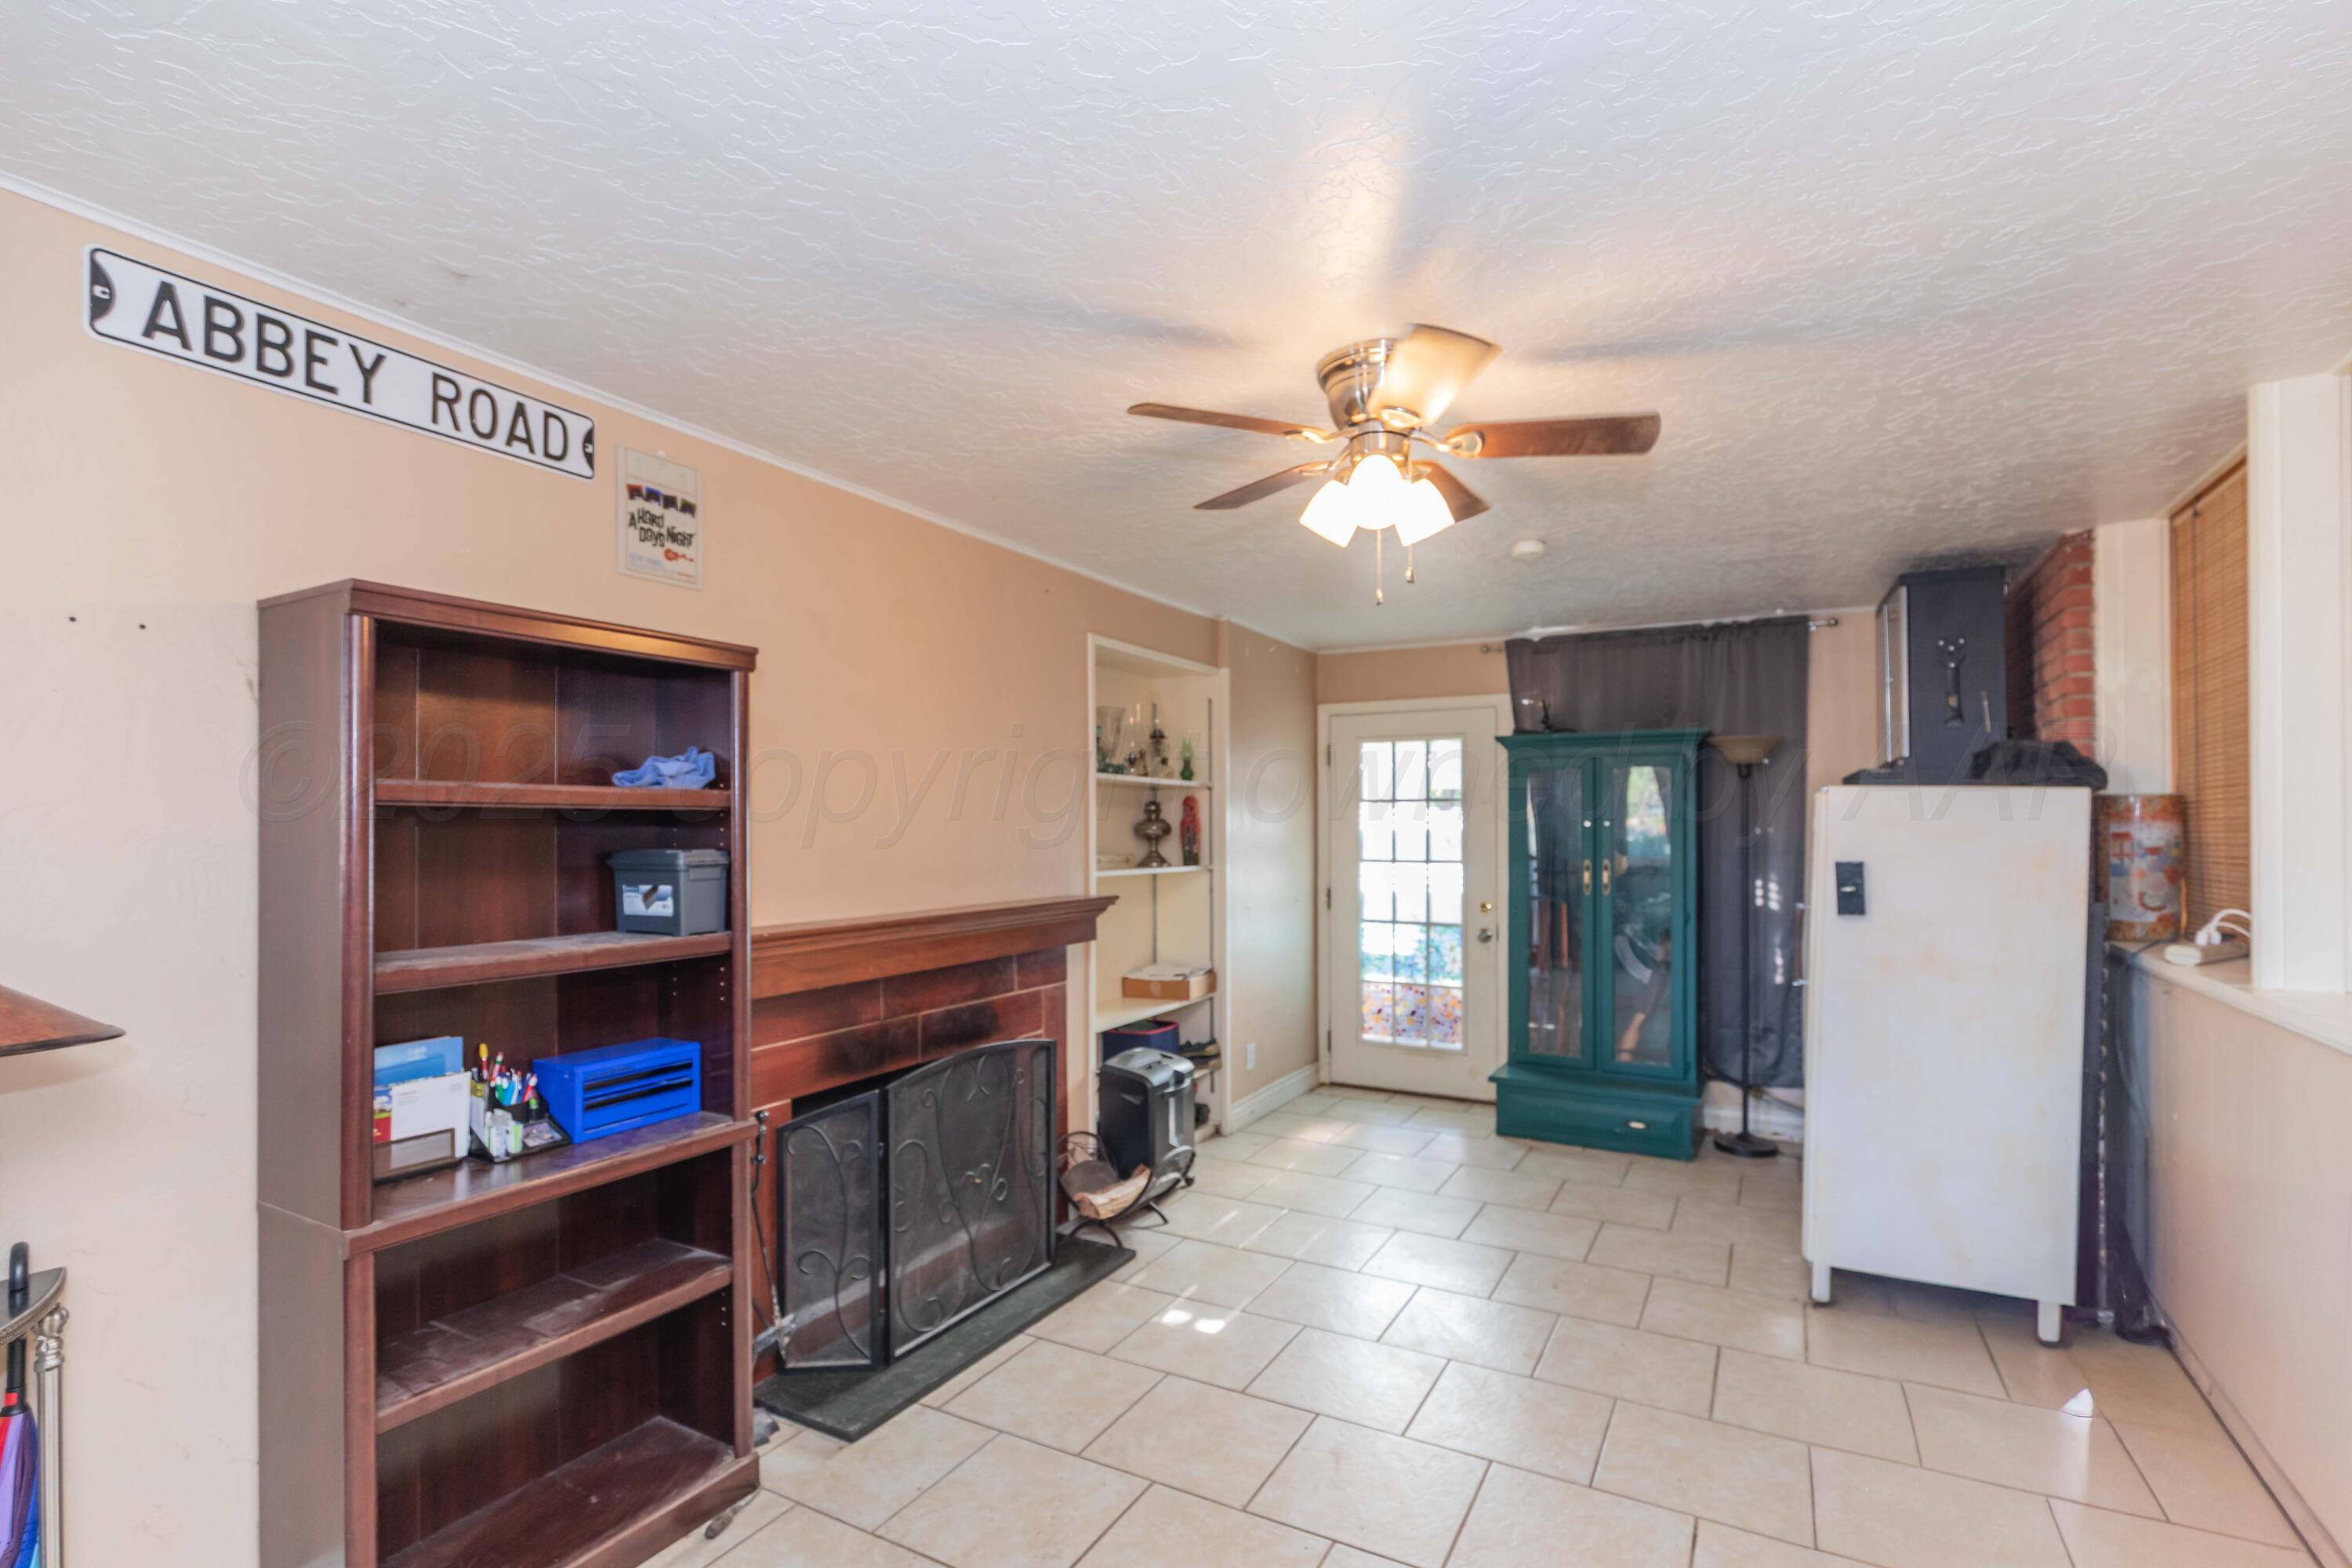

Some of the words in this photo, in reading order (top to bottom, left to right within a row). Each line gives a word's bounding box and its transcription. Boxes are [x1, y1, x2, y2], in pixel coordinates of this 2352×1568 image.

[142, 281, 386, 405] ABBEY
[433, 372, 568, 461] ROAD
[628, 512, 637, 530] A
